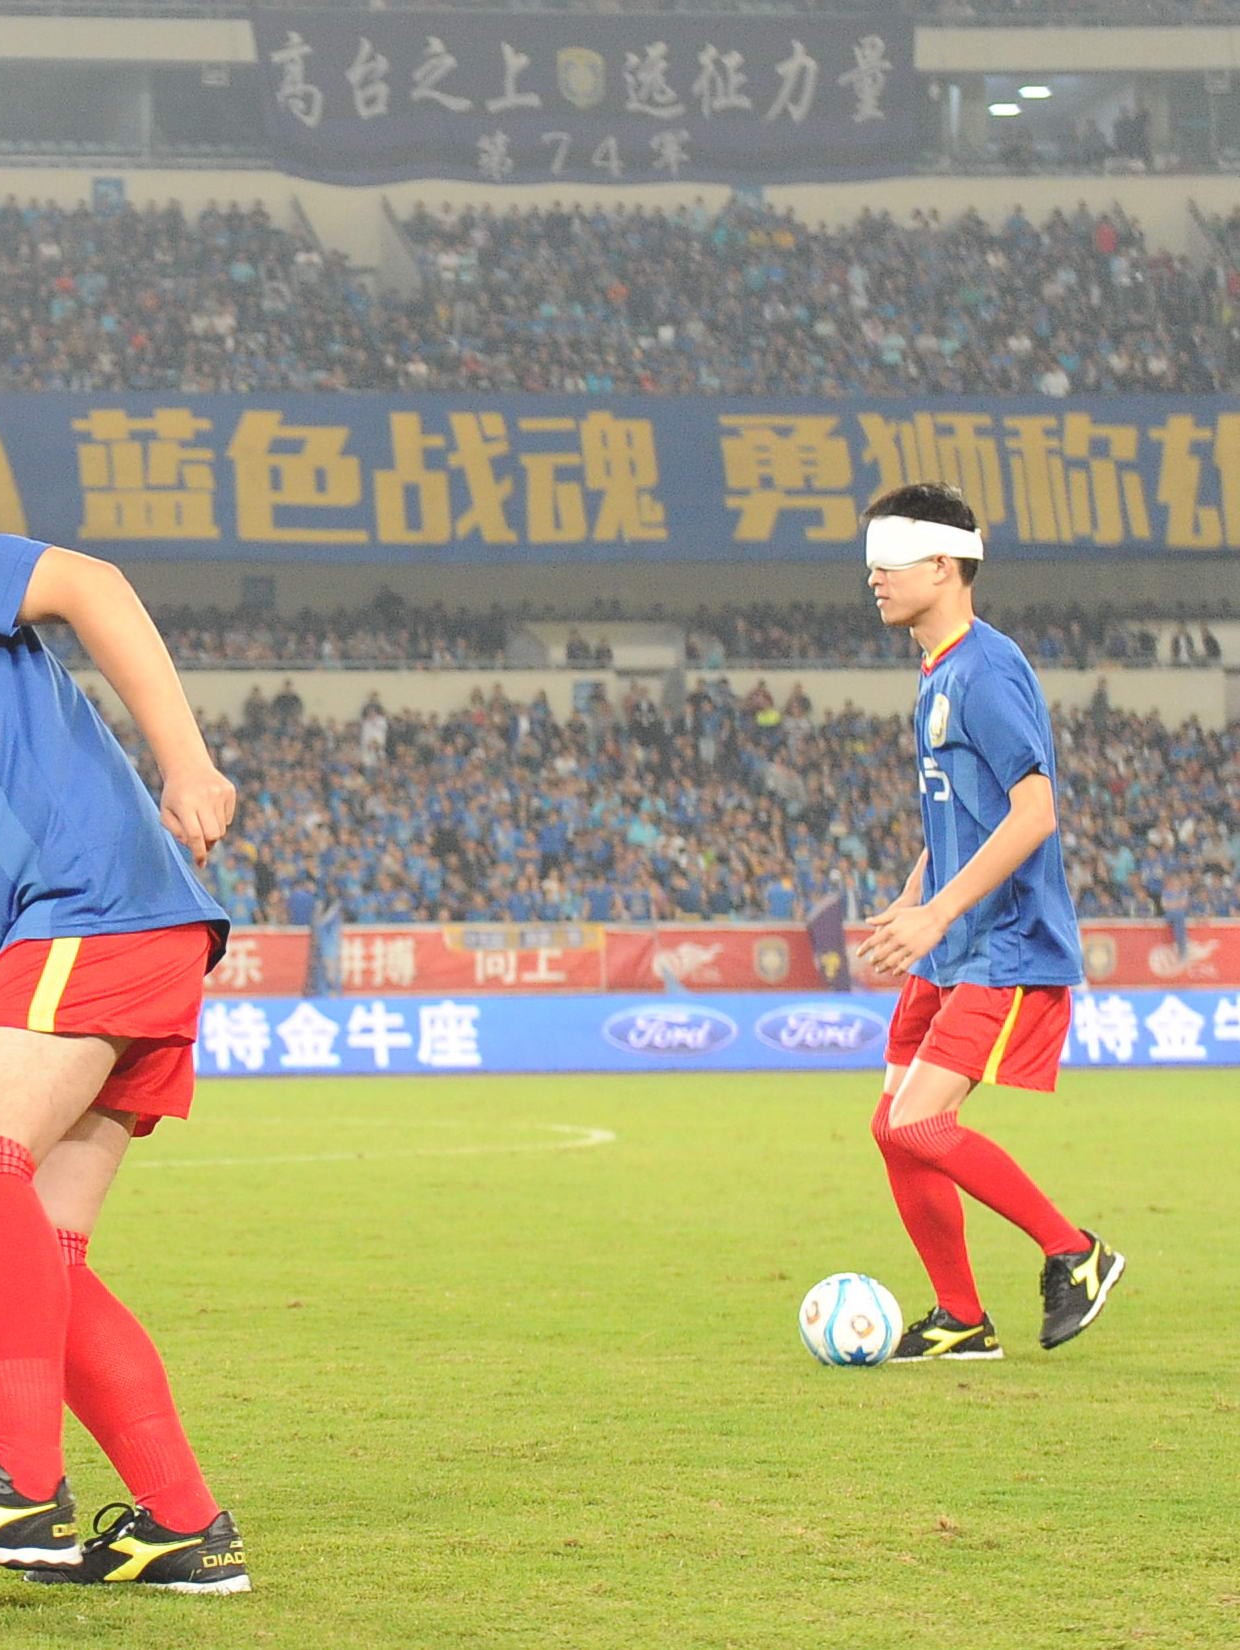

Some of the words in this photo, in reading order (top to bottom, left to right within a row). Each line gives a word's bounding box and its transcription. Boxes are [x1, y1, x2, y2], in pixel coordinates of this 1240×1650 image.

[270, 30, 542, 127] 高台之上
[71, 408, 669, 544] 蓝色战魂
[194, 1001, 482, 1071] 特金牛座
[627, 1012, 711, 1049] Ford
[780, 1012, 863, 1049] Ford
